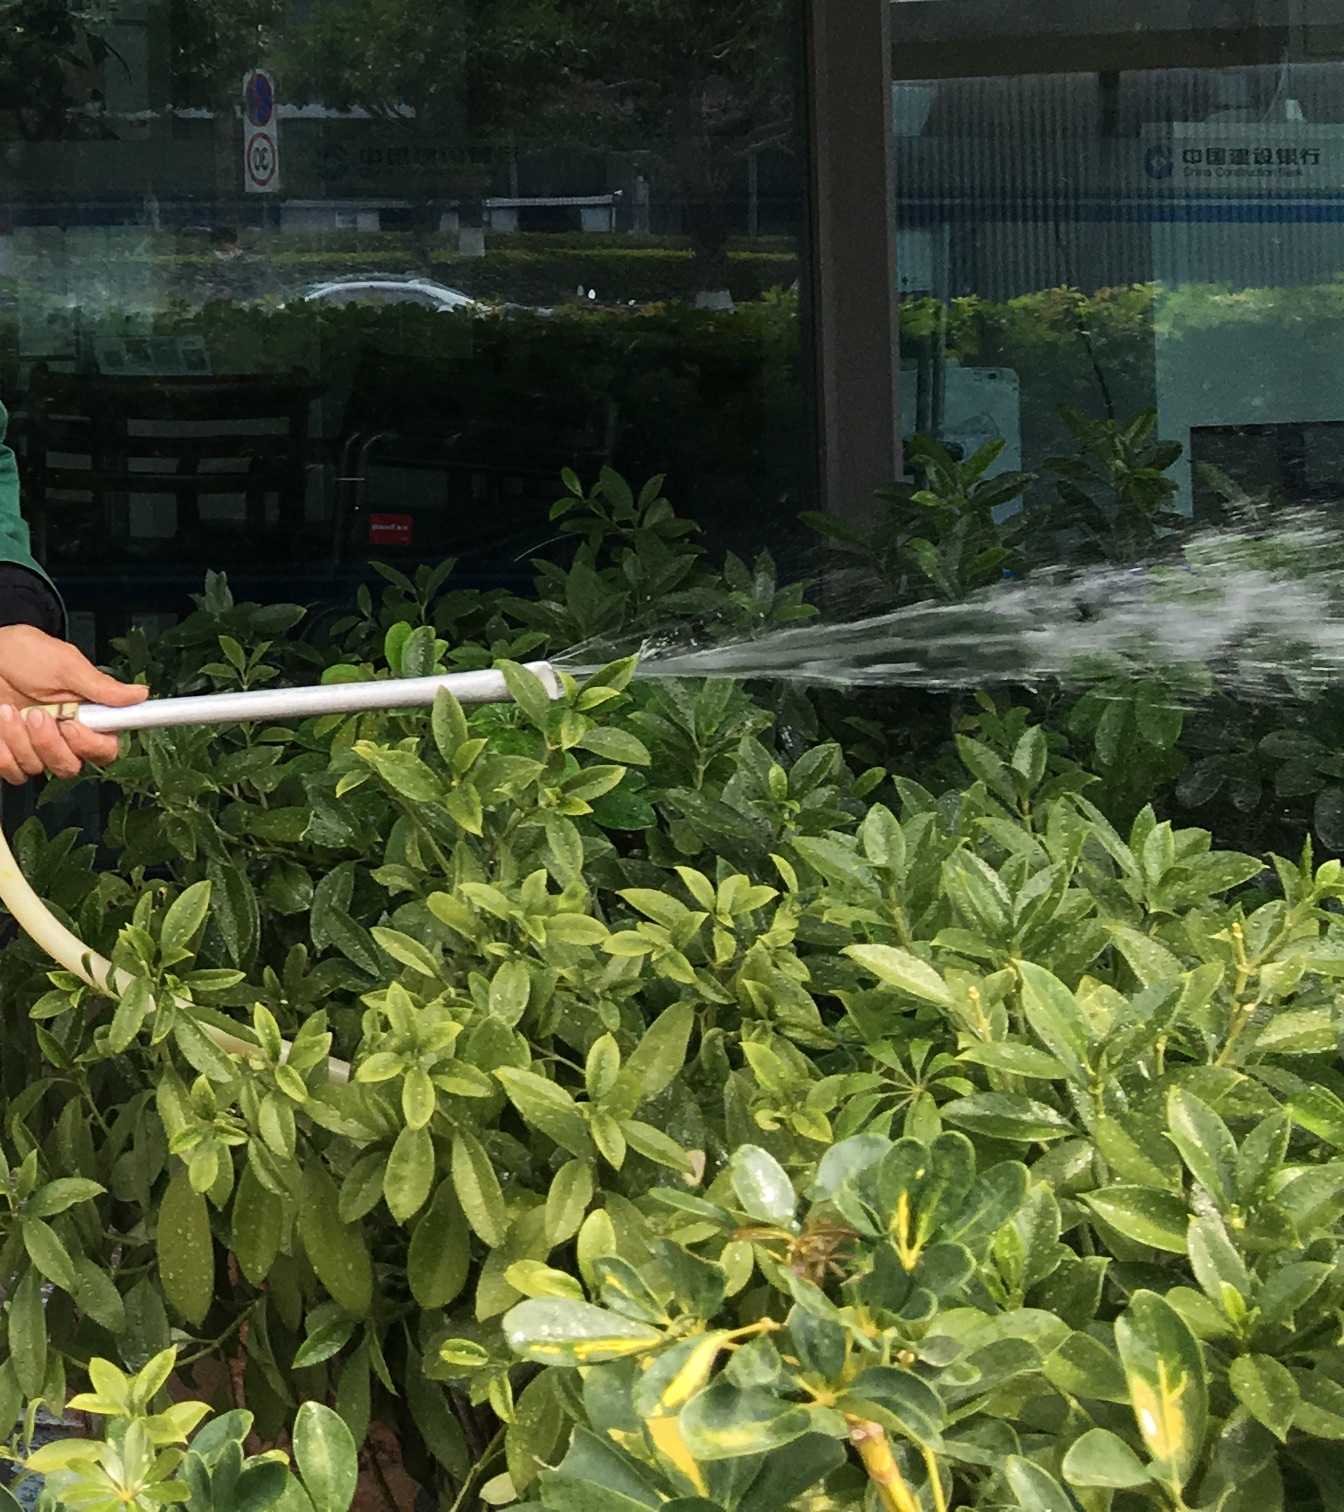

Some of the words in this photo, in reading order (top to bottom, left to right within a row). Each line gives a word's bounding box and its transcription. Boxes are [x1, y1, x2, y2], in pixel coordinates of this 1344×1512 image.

[1182, 147, 1321, 166] 中国建设银行
